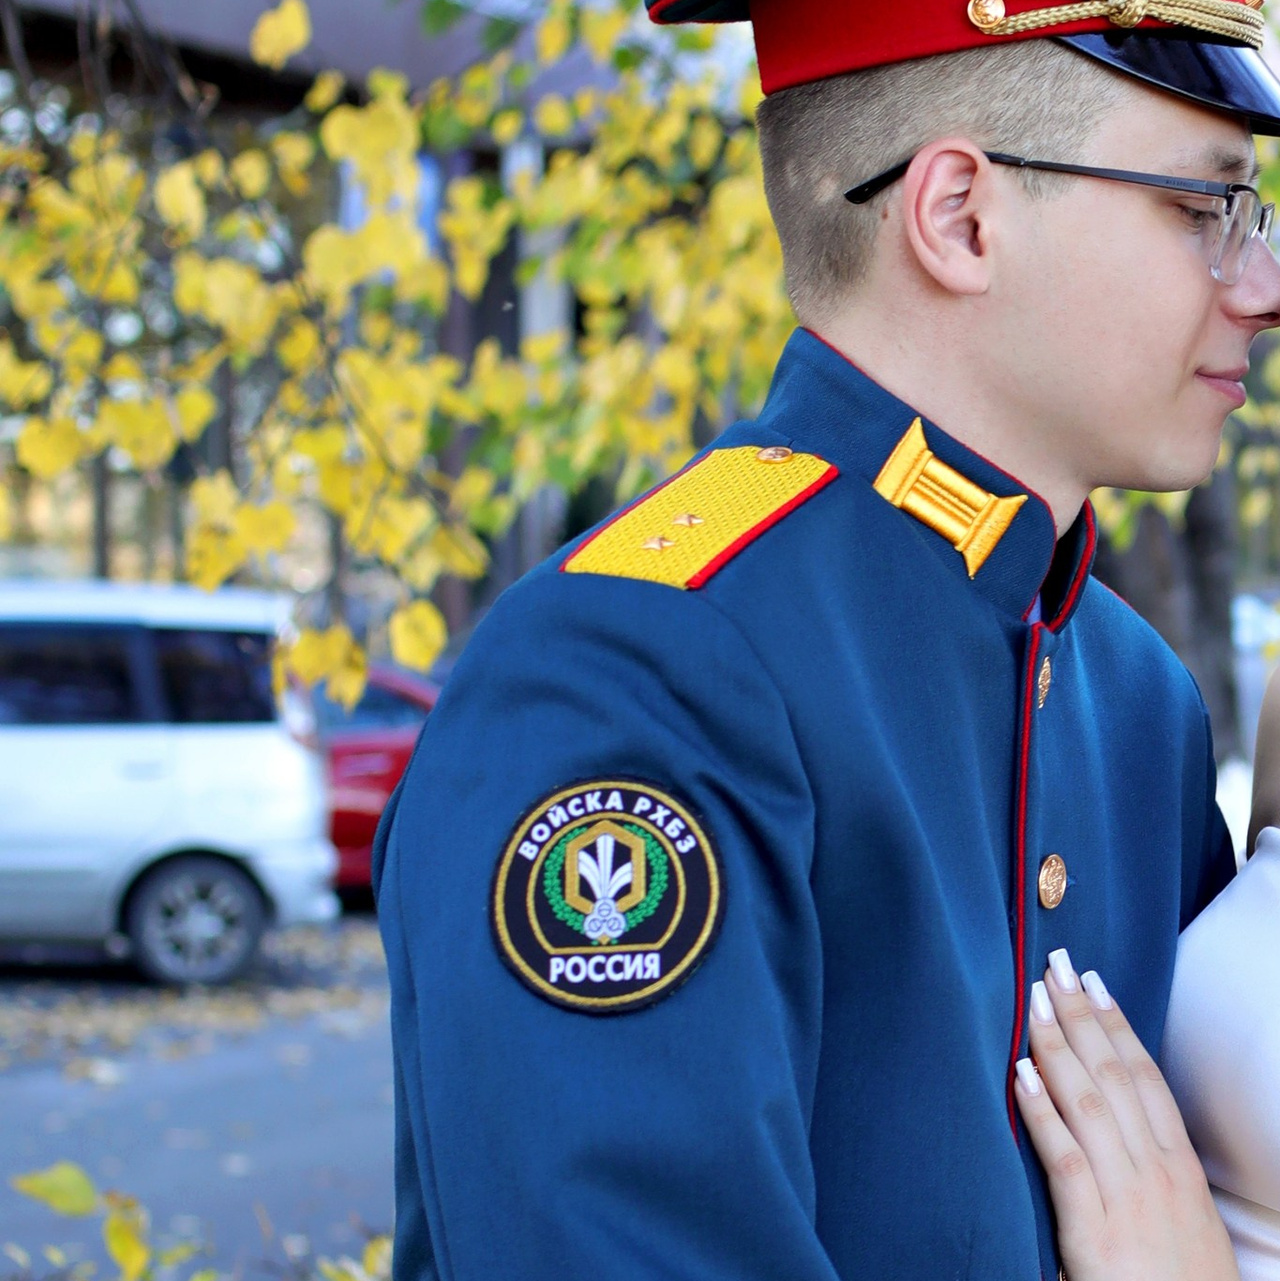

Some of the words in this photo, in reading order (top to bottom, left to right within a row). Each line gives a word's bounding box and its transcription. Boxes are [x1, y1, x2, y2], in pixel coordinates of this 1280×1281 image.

[518, 790, 623, 861] ВОЙСКА
[633, 796, 696, 854] РХБЗ
[550, 952, 660, 983] РОССИЯ
